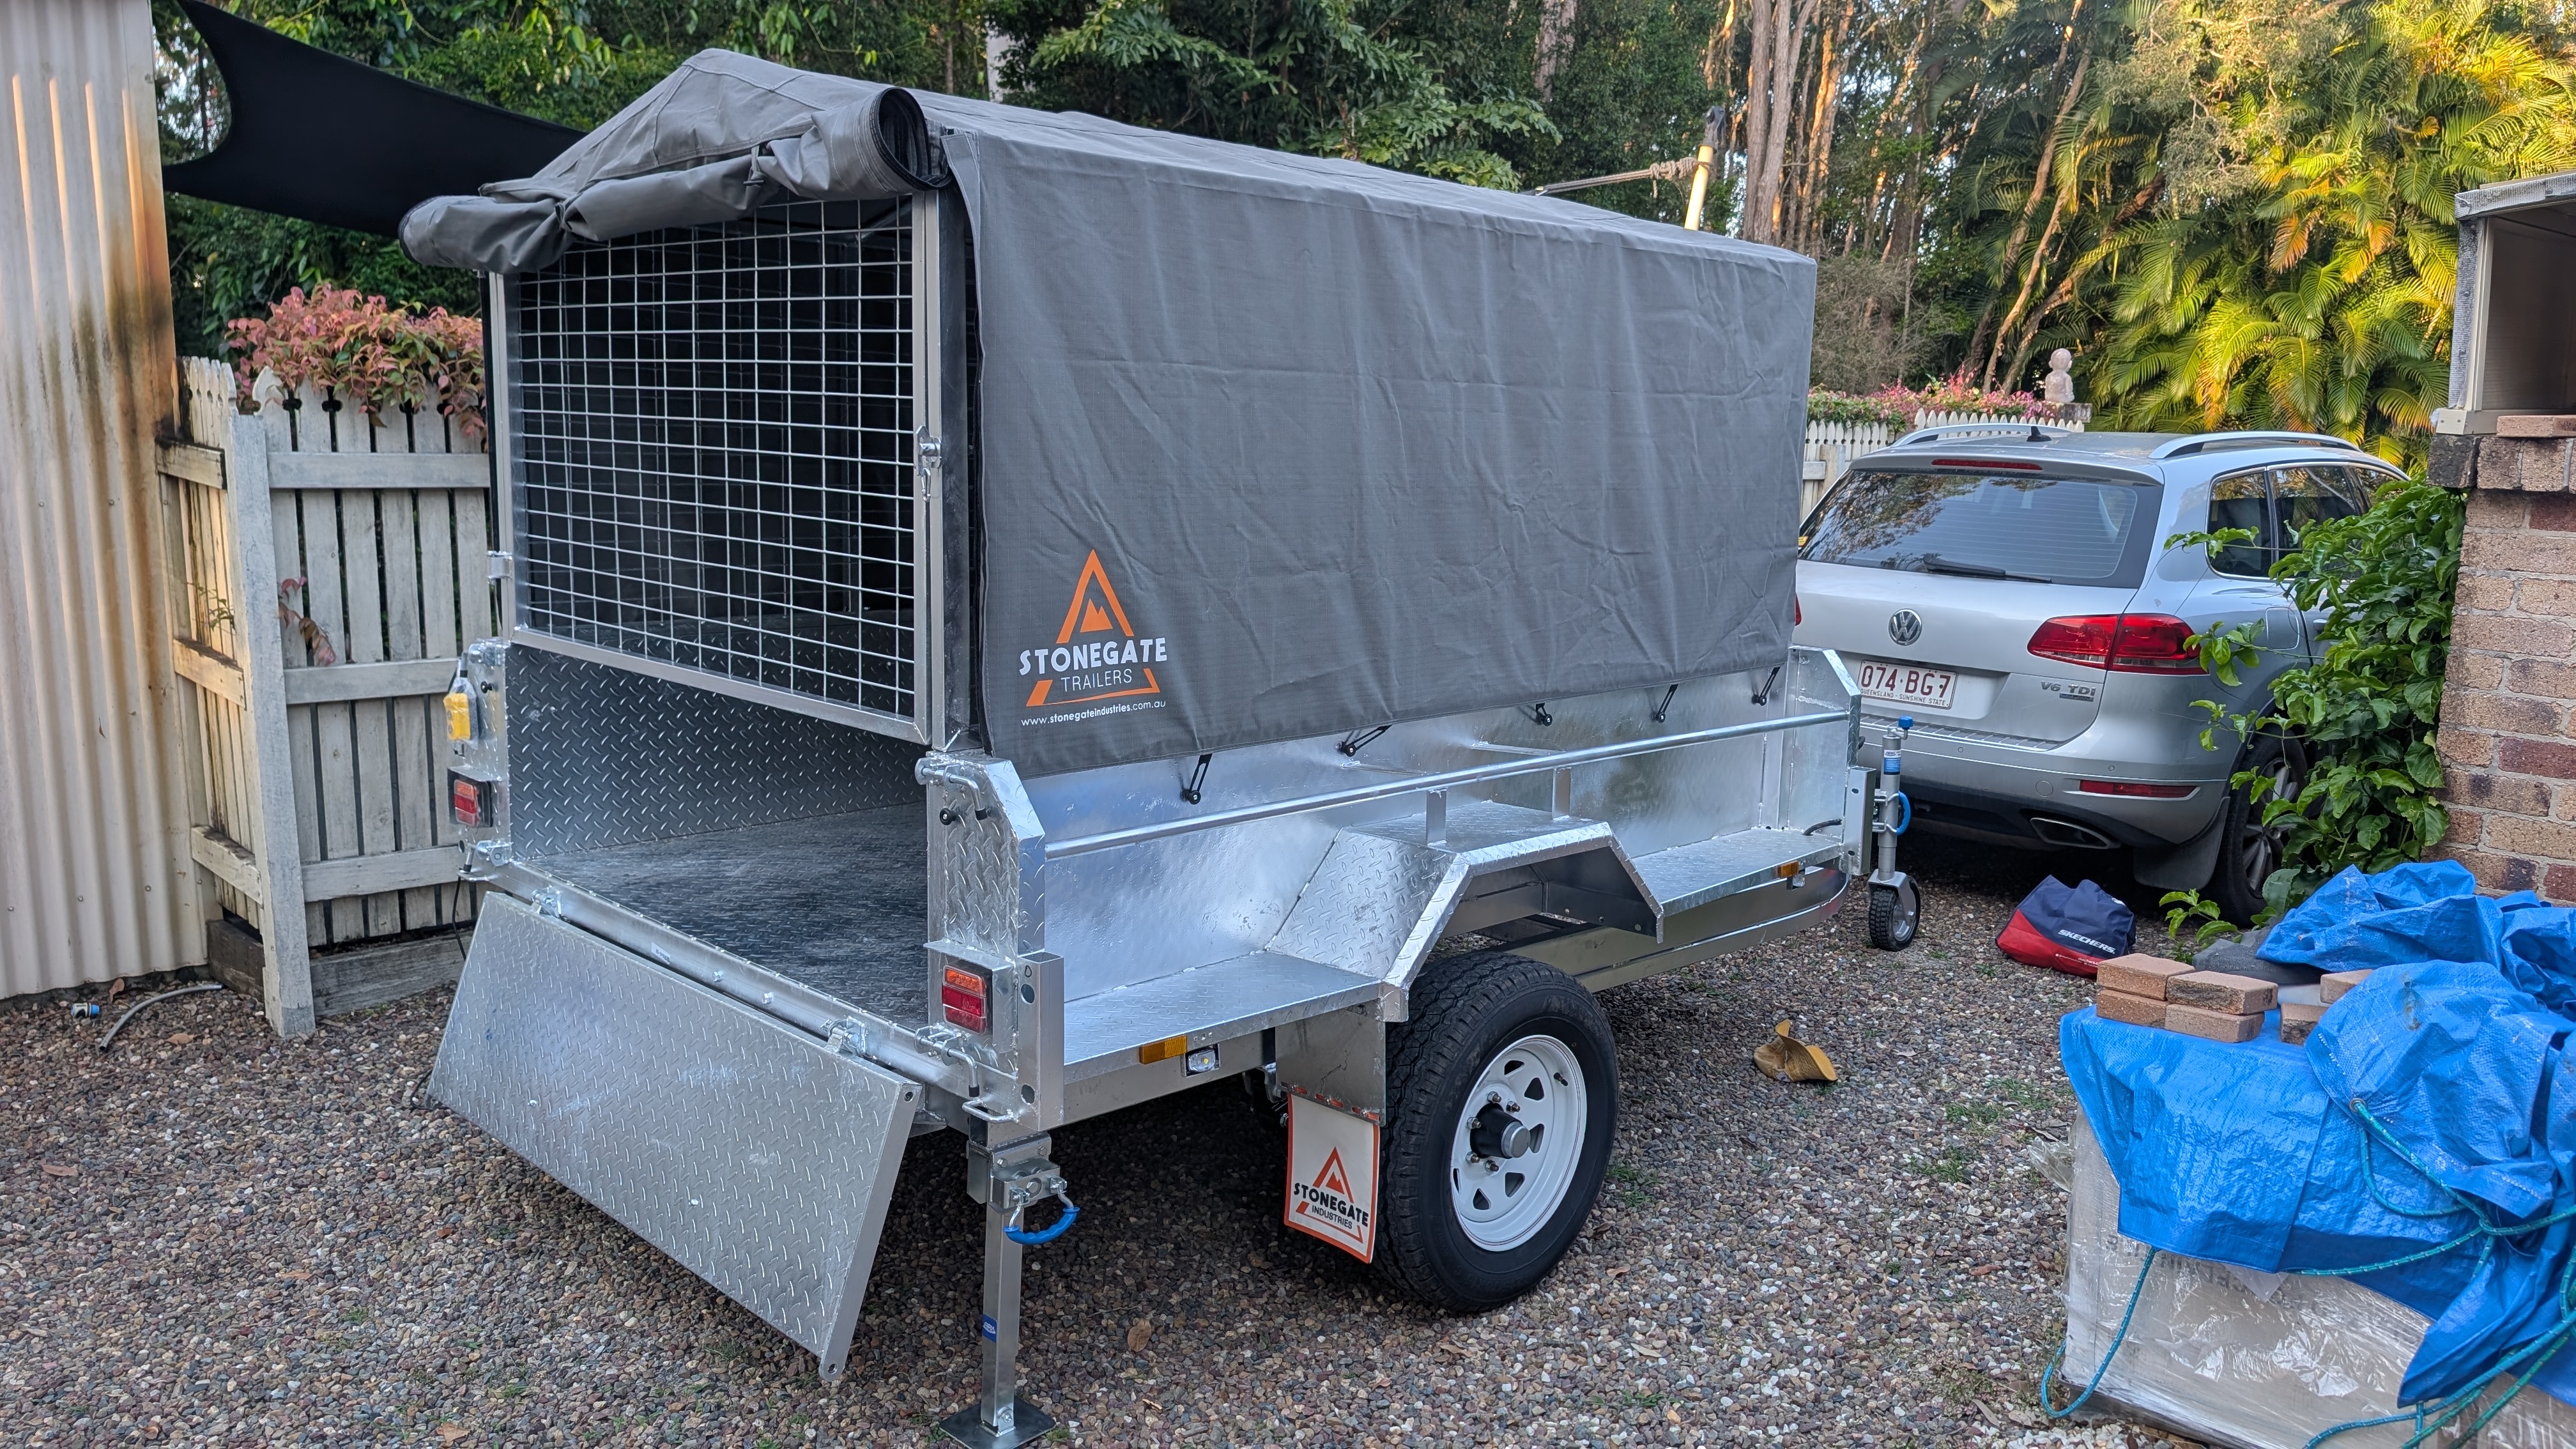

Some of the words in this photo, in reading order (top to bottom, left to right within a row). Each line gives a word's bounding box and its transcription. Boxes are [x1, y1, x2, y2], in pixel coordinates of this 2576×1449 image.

[1019, 638, 1167, 675] STONEGATE
[1061, 669, 1132, 692] TRAILERS
[1861, 665, 1898, 691] 074
[1905, 670, 1951, 698] BG7
[2041, 680, 2062, 692] V6
[2068, 684, 2096, 696] TDI
[1860, 688, 1894, 698] QUEENSLAND
[1899, 694, 1926, 703] SUNSHINE
[1928, 698, 1946, 706] STATE
[1021, 700, 1166, 726] www.stonegateindustries.com.au
[2057, 929, 2116, 953] SKECHERS
[1293, 1183, 1369, 1227] STONEGATE
[1312, 1204, 1353, 1230] INDUSTRIES
